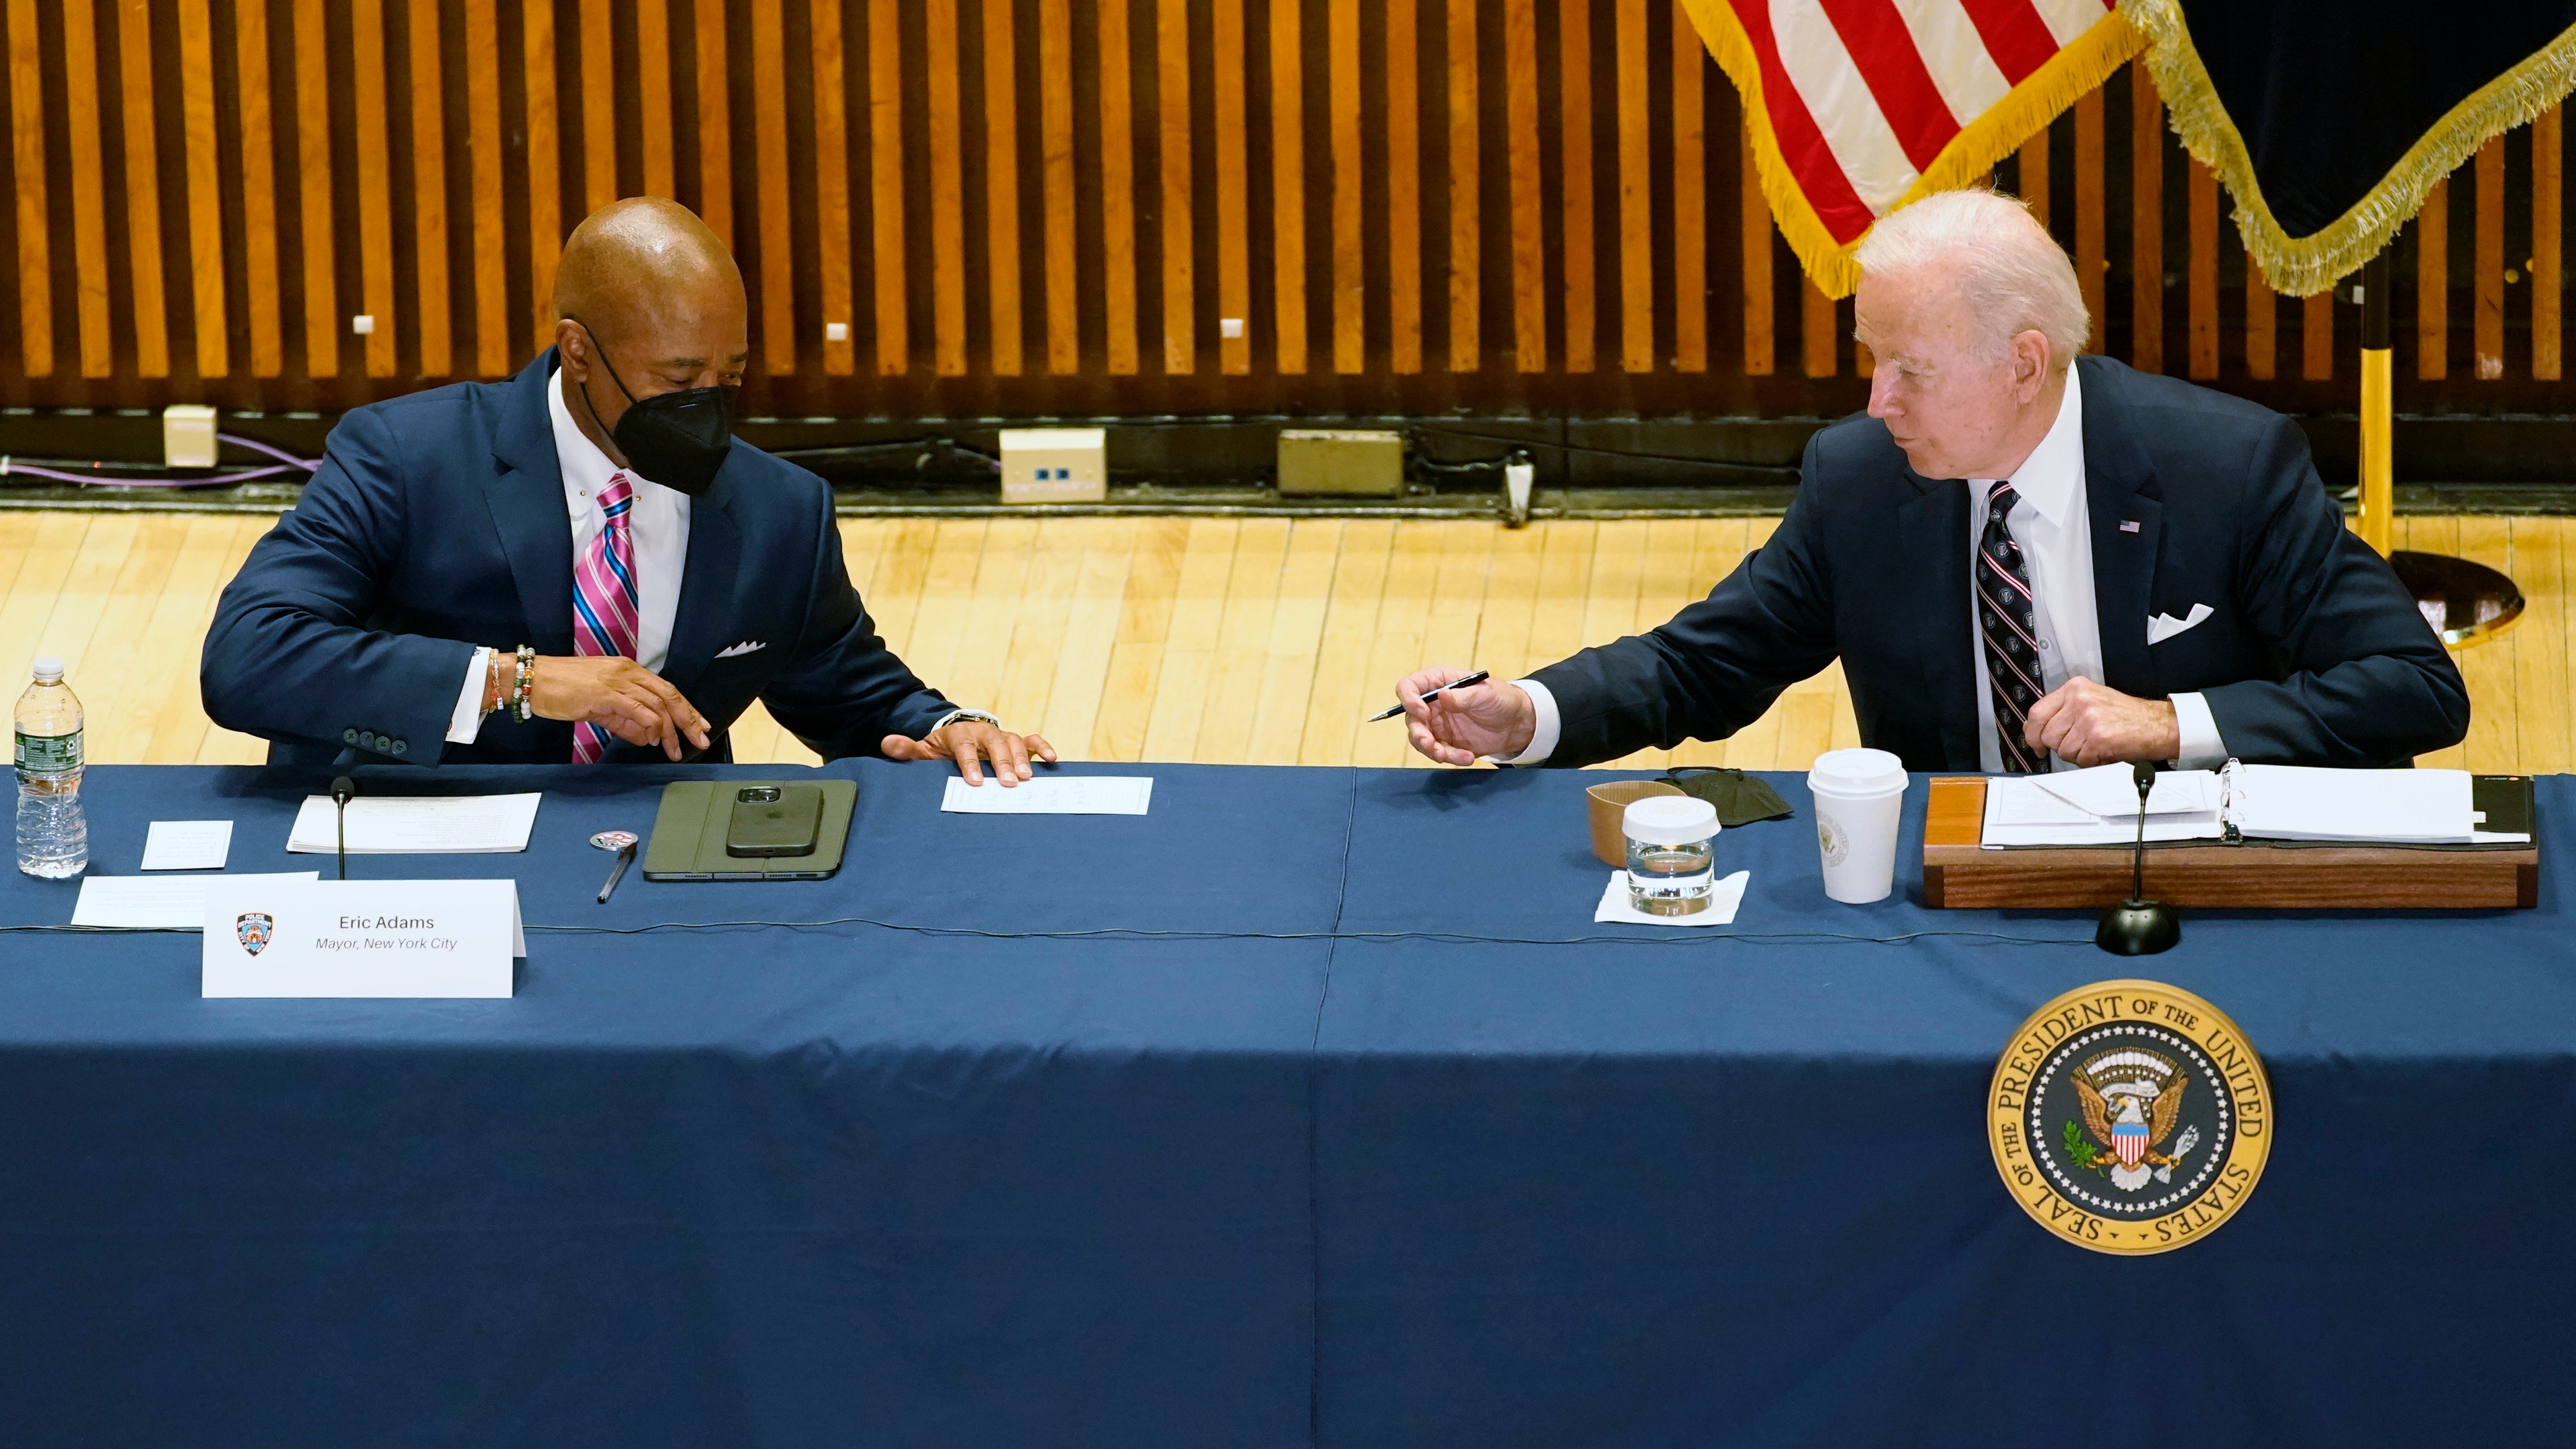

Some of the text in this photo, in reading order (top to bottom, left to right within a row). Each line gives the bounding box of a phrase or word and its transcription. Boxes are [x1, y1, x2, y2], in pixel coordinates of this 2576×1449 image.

[238, 919, 272, 928] DEPARTMENT
[340, 916, 434, 929] Eric Adams
[316, 938, 458, 951] Mayor, New York City
[1998, 995, 2264, 1242] SEAL OF THE PRESIDENT OF THE UNITED STATES
